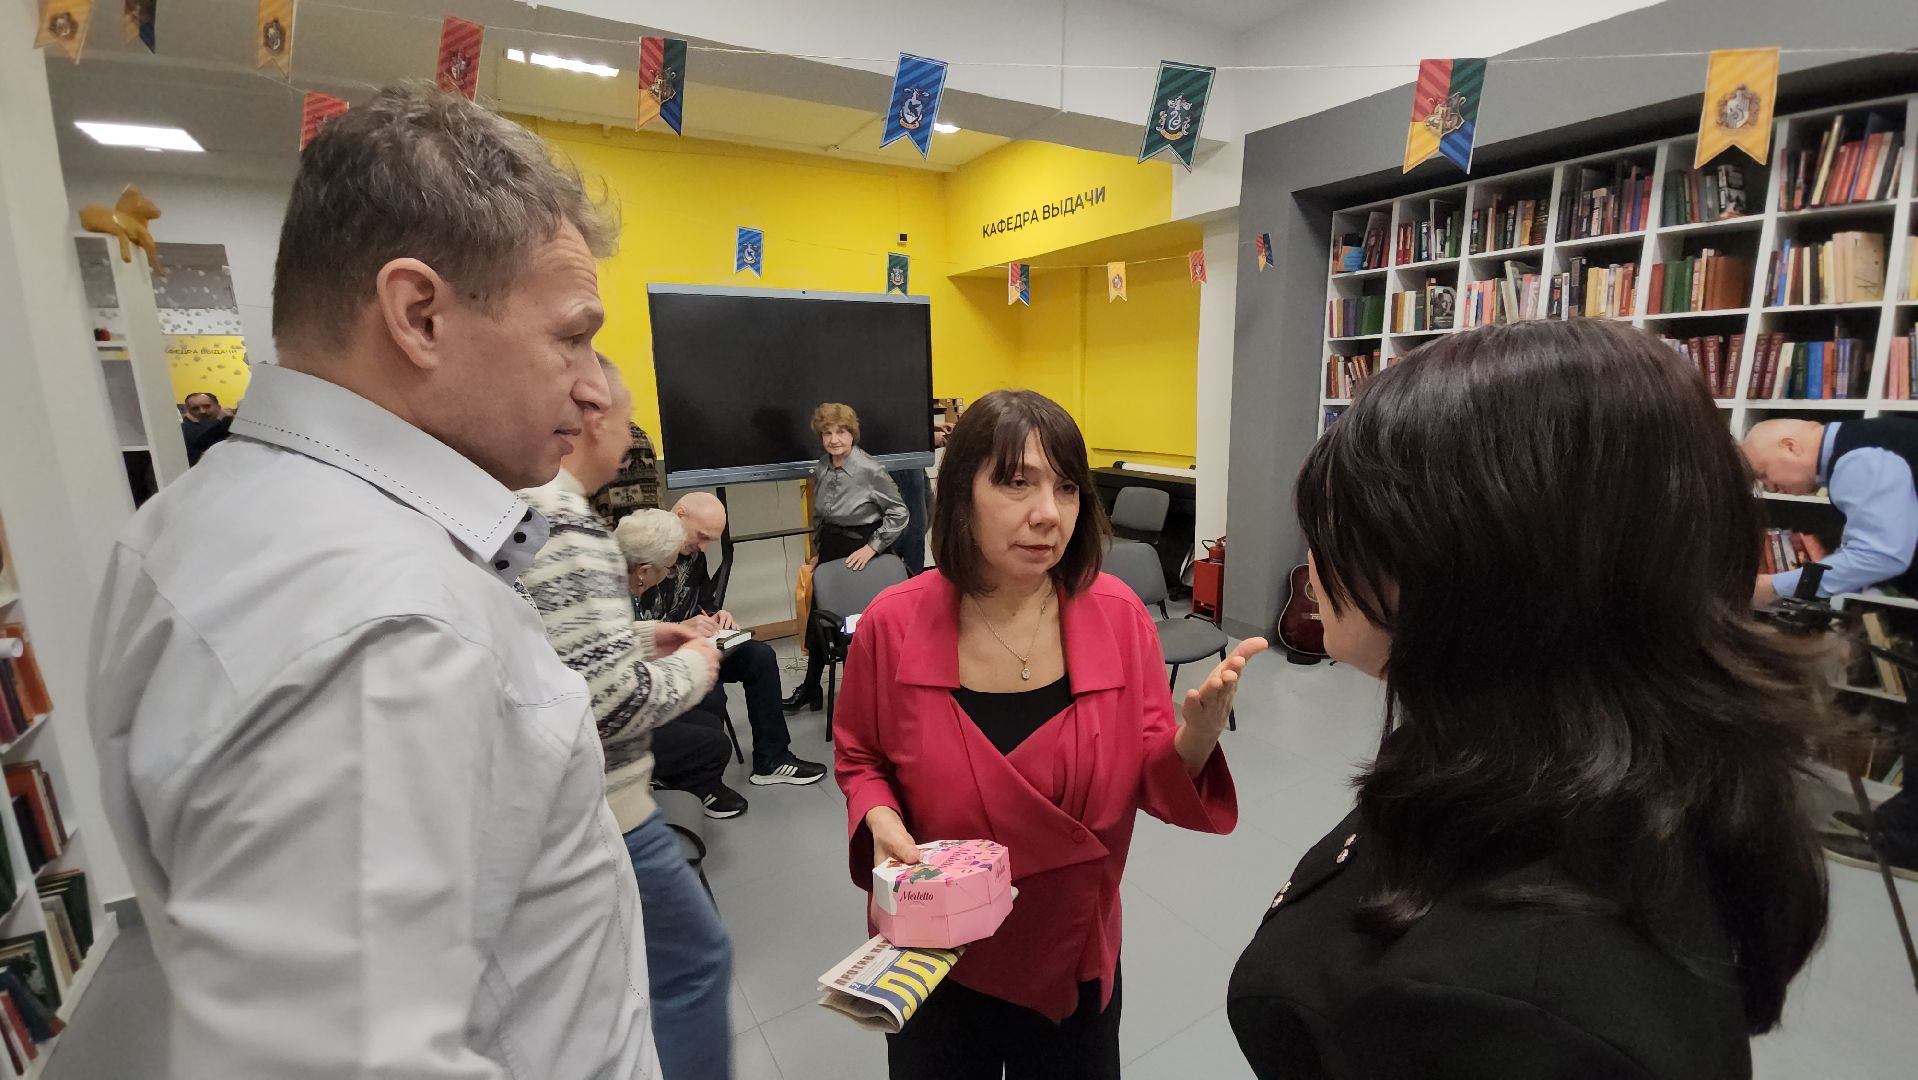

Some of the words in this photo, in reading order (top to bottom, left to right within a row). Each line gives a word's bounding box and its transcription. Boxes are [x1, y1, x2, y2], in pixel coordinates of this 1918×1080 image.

[982, 208, 1040, 239] КАФЕДРА
[1042, 185, 1106, 221] ВЫДАЧИ
[900, 890, 934, 902] Merletto
[834, 955, 876, 986] ПРОТИВ
